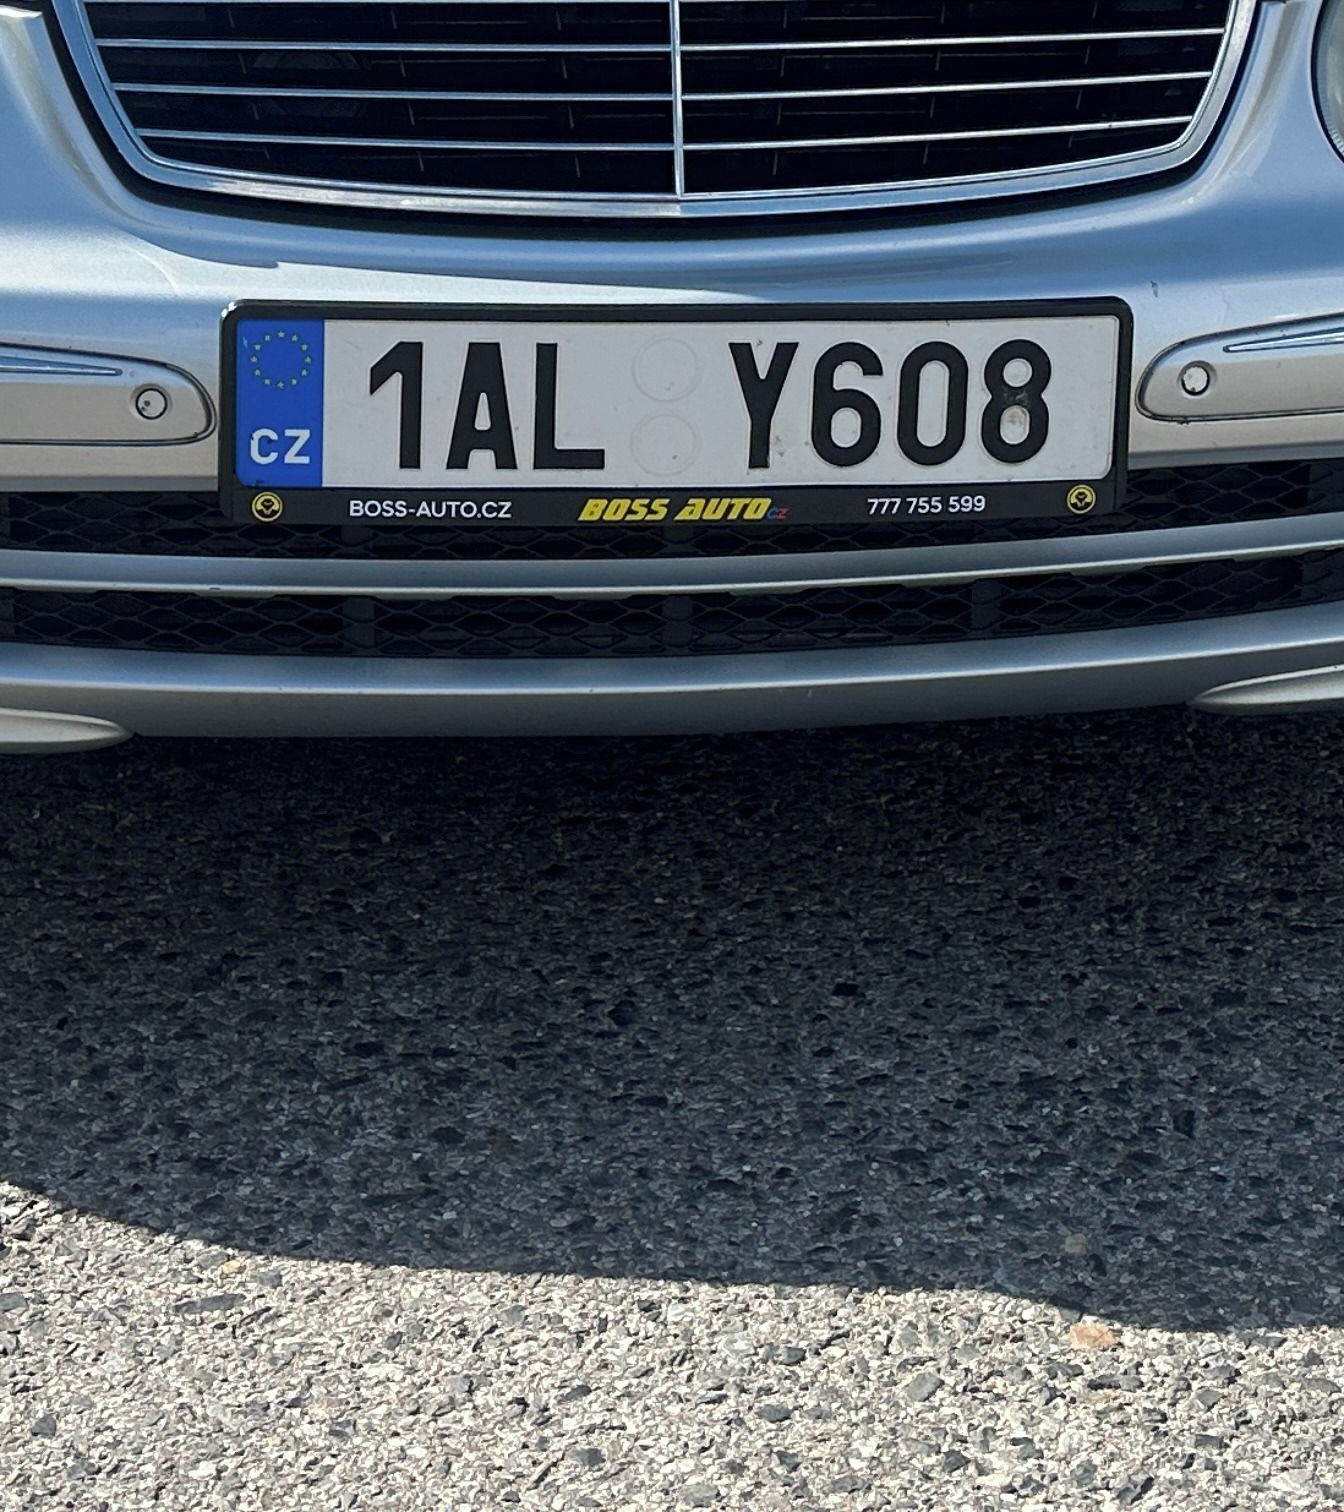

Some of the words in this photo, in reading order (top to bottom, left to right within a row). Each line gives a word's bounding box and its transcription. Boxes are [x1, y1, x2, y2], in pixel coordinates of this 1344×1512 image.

[370, 341, 605, 470] 1AL
[728, 338, 1052, 470] Y608
[250, 428, 311, 464] CZ
[349, 500, 512, 519] BOSS-AUTO.CZ
[577, 498, 670, 522] BOSS
[674, 497, 771, 521] AUTO
[867, 498, 904, 515] 777
[906, 496, 942, 514] 755
[948, 495, 986, 514] 599
